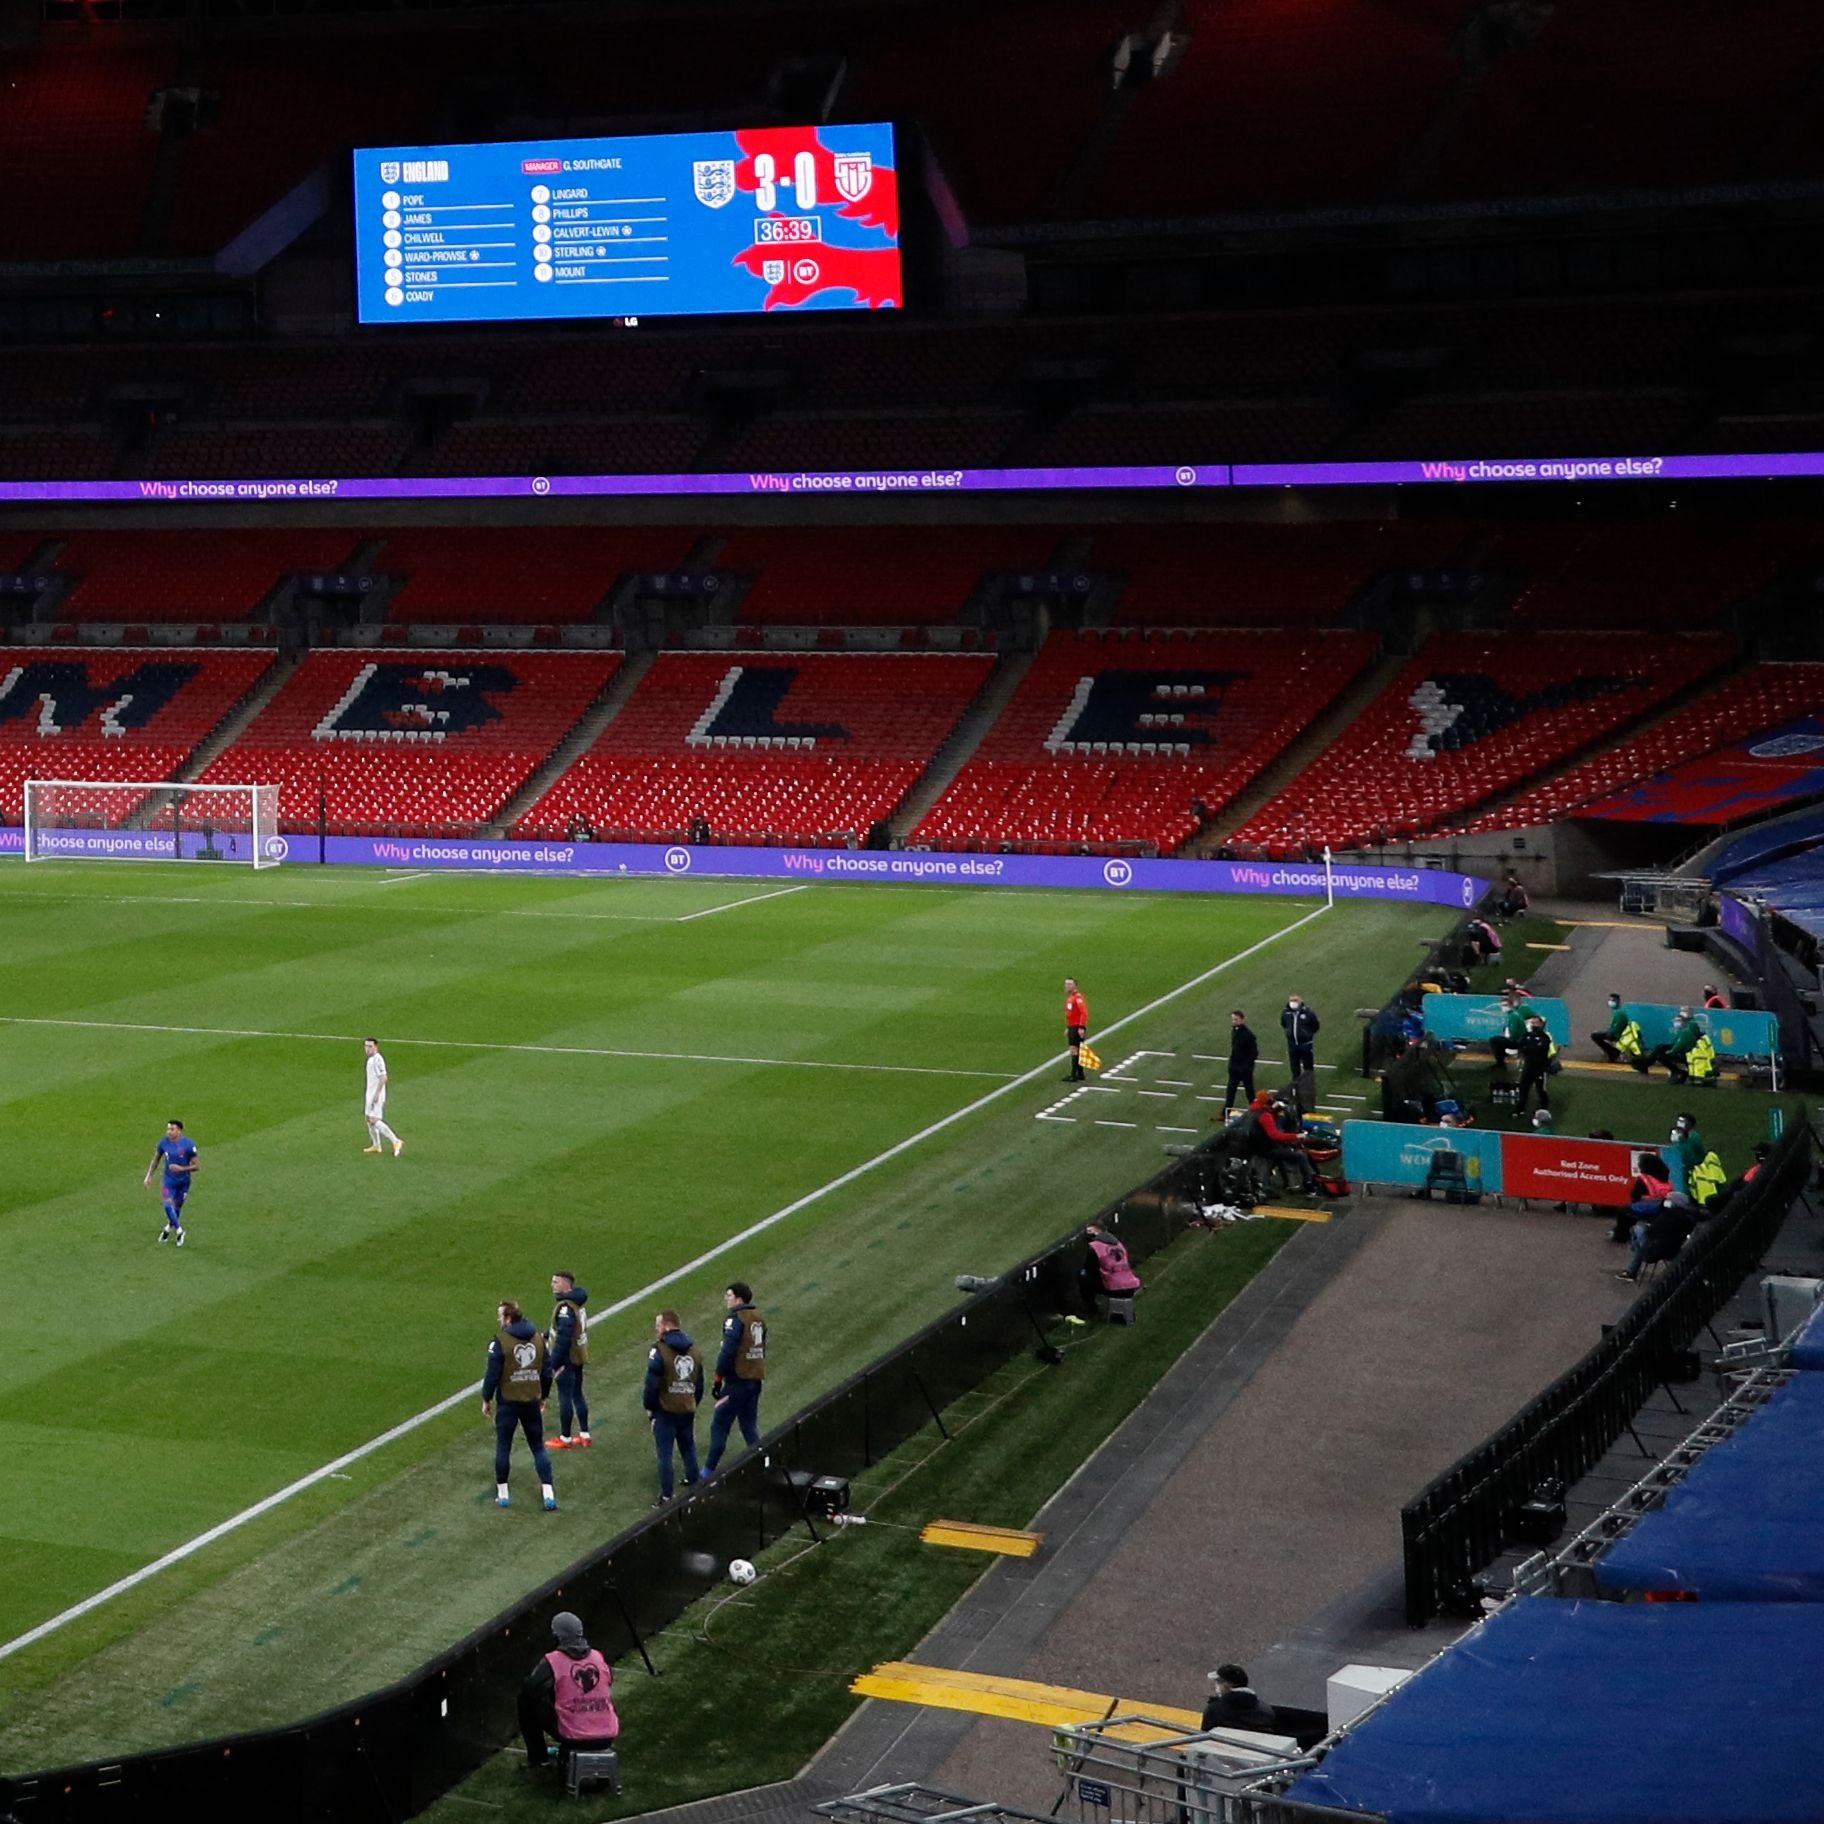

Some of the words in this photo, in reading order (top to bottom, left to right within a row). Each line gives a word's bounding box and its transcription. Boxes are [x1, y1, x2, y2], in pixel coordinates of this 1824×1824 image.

[524, 162, 558, 171] MANAGER
[573, 158, 622, 170] SOUTHGATE
[403, 161, 448, 183] ENGLAND
[403, 195, 424, 205] POPE
[552, 189, 588, 200] LINGARD
[404, 214, 432, 224] JAMES
[553, 208, 588, 218] PHILLIPS
[554, 226, 619, 238] CALVERT-LEWIN
[761, 221, 812, 242] 36:39
[404, 233, 444, 243] CHILWELL
[405, 251, 467, 262] WARD-PROWSE
[555, 246, 593, 257] STERLING
[405, 271, 437, 282] STONES
[555, 266, 586, 276] MOUNT
[406, 291, 434, 302] COADY
[624, 317, 638, 327] LG
[1421, 462, 1466, 481] Why
[1469, 461, 1536, 478] choose
[1540, 462, 1611, 479] anyone
[1613, 458, 1662, 475] else?
[751, 474, 789, 491] Why
[792, 474, 852, 489] choose
[854, 475, 918, 491] anyone
[921, 471, 963, 487] else?
[140, 482, 177, 498] Why
[179, 482, 234, 496] choose
[237, 484, 296, 498] anyone
[299, 480, 338, 494] else?
[37, 833, 84, 849] choose
[87, 837, 138, 852] anyone
[373, 842, 409, 860] Why
[413, 845, 469, 859] choose
[472, 847, 532, 864] anyone
[534, 847, 574, 863] else?
[783, 854, 824, 872] Why
[827, 855, 889, 871] choose
[891, 858, 957, 877] anyone
[960, 858, 1004, 875] else?
[1231, 867, 1270, 887] Why
[1272, 867, 1327, 885] choose
[1330, 871, 1385, 890] anyone
[1387, 872, 1419, 890] else?
[1560, 1159, 1577, 1169] Red
[1578, 1161, 1600, 1171] Zone
[1533, 1167, 1578, 1179] Authorised
[1579, 1172, 1607, 1182] Access
[1608, 1174, 1629, 1185] Only
